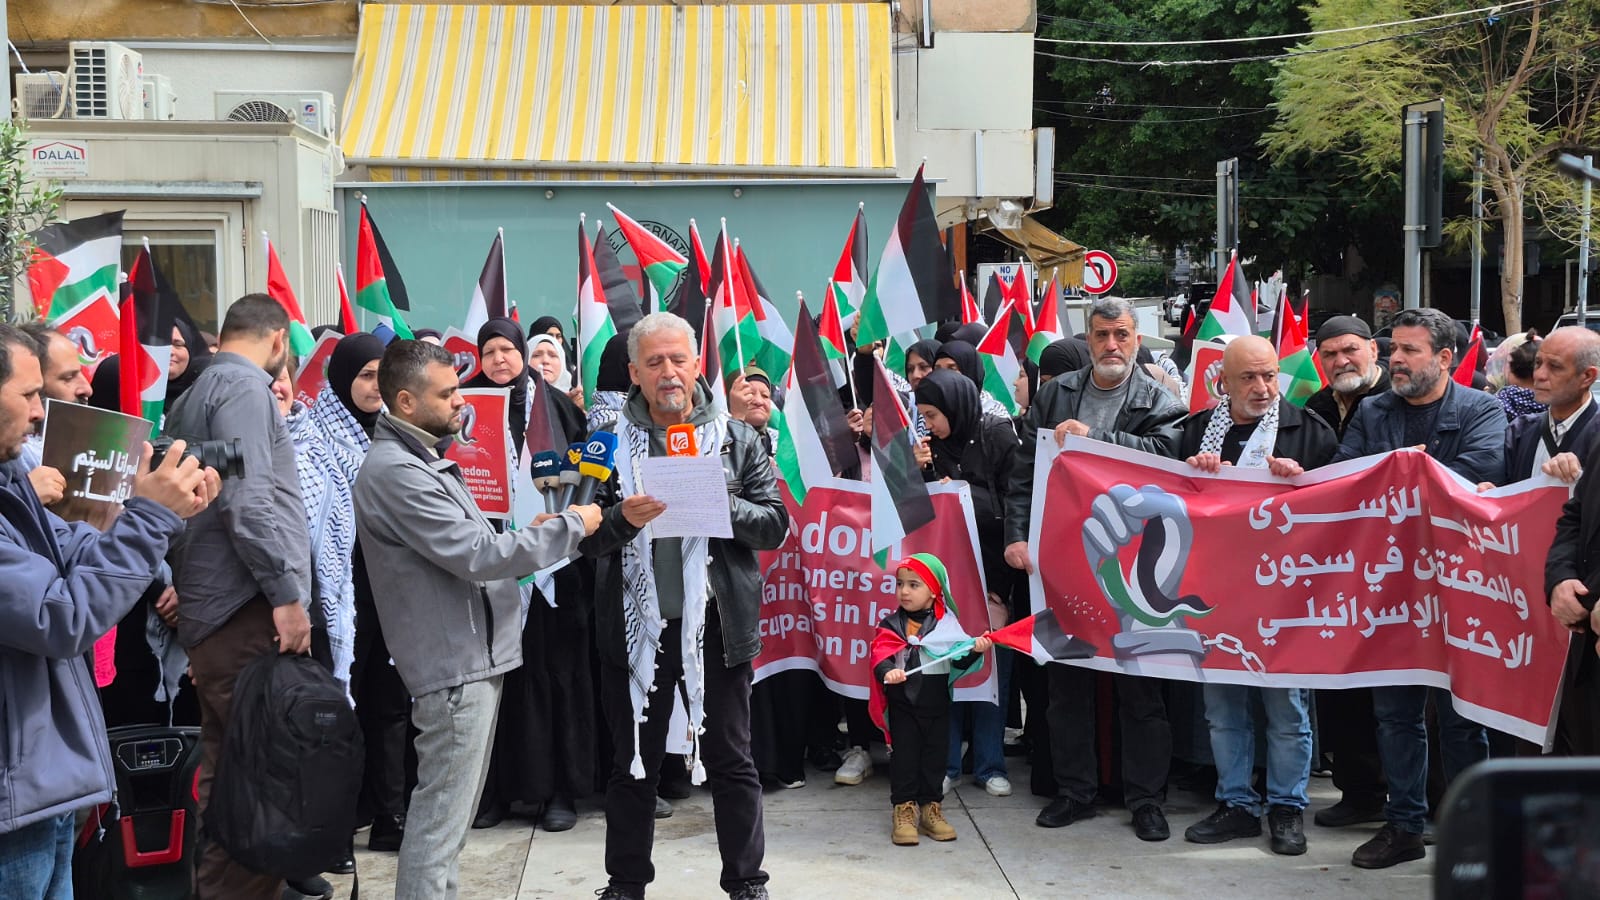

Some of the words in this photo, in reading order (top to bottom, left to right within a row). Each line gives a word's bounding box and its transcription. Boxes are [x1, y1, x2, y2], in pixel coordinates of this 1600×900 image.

[38, 150, 80, 160] DALAL
[461, 466, 490, 477] eedom
[483, 493, 503, 501] prisons
[1249, 485, 1422, 534] للأسرى
[1255, 549, 1355, 588] سجون
[1363, 535, 1404, 592] في
[834, 596, 860, 625] in
[1257, 592, 1440, 647] الإسرائيلي
